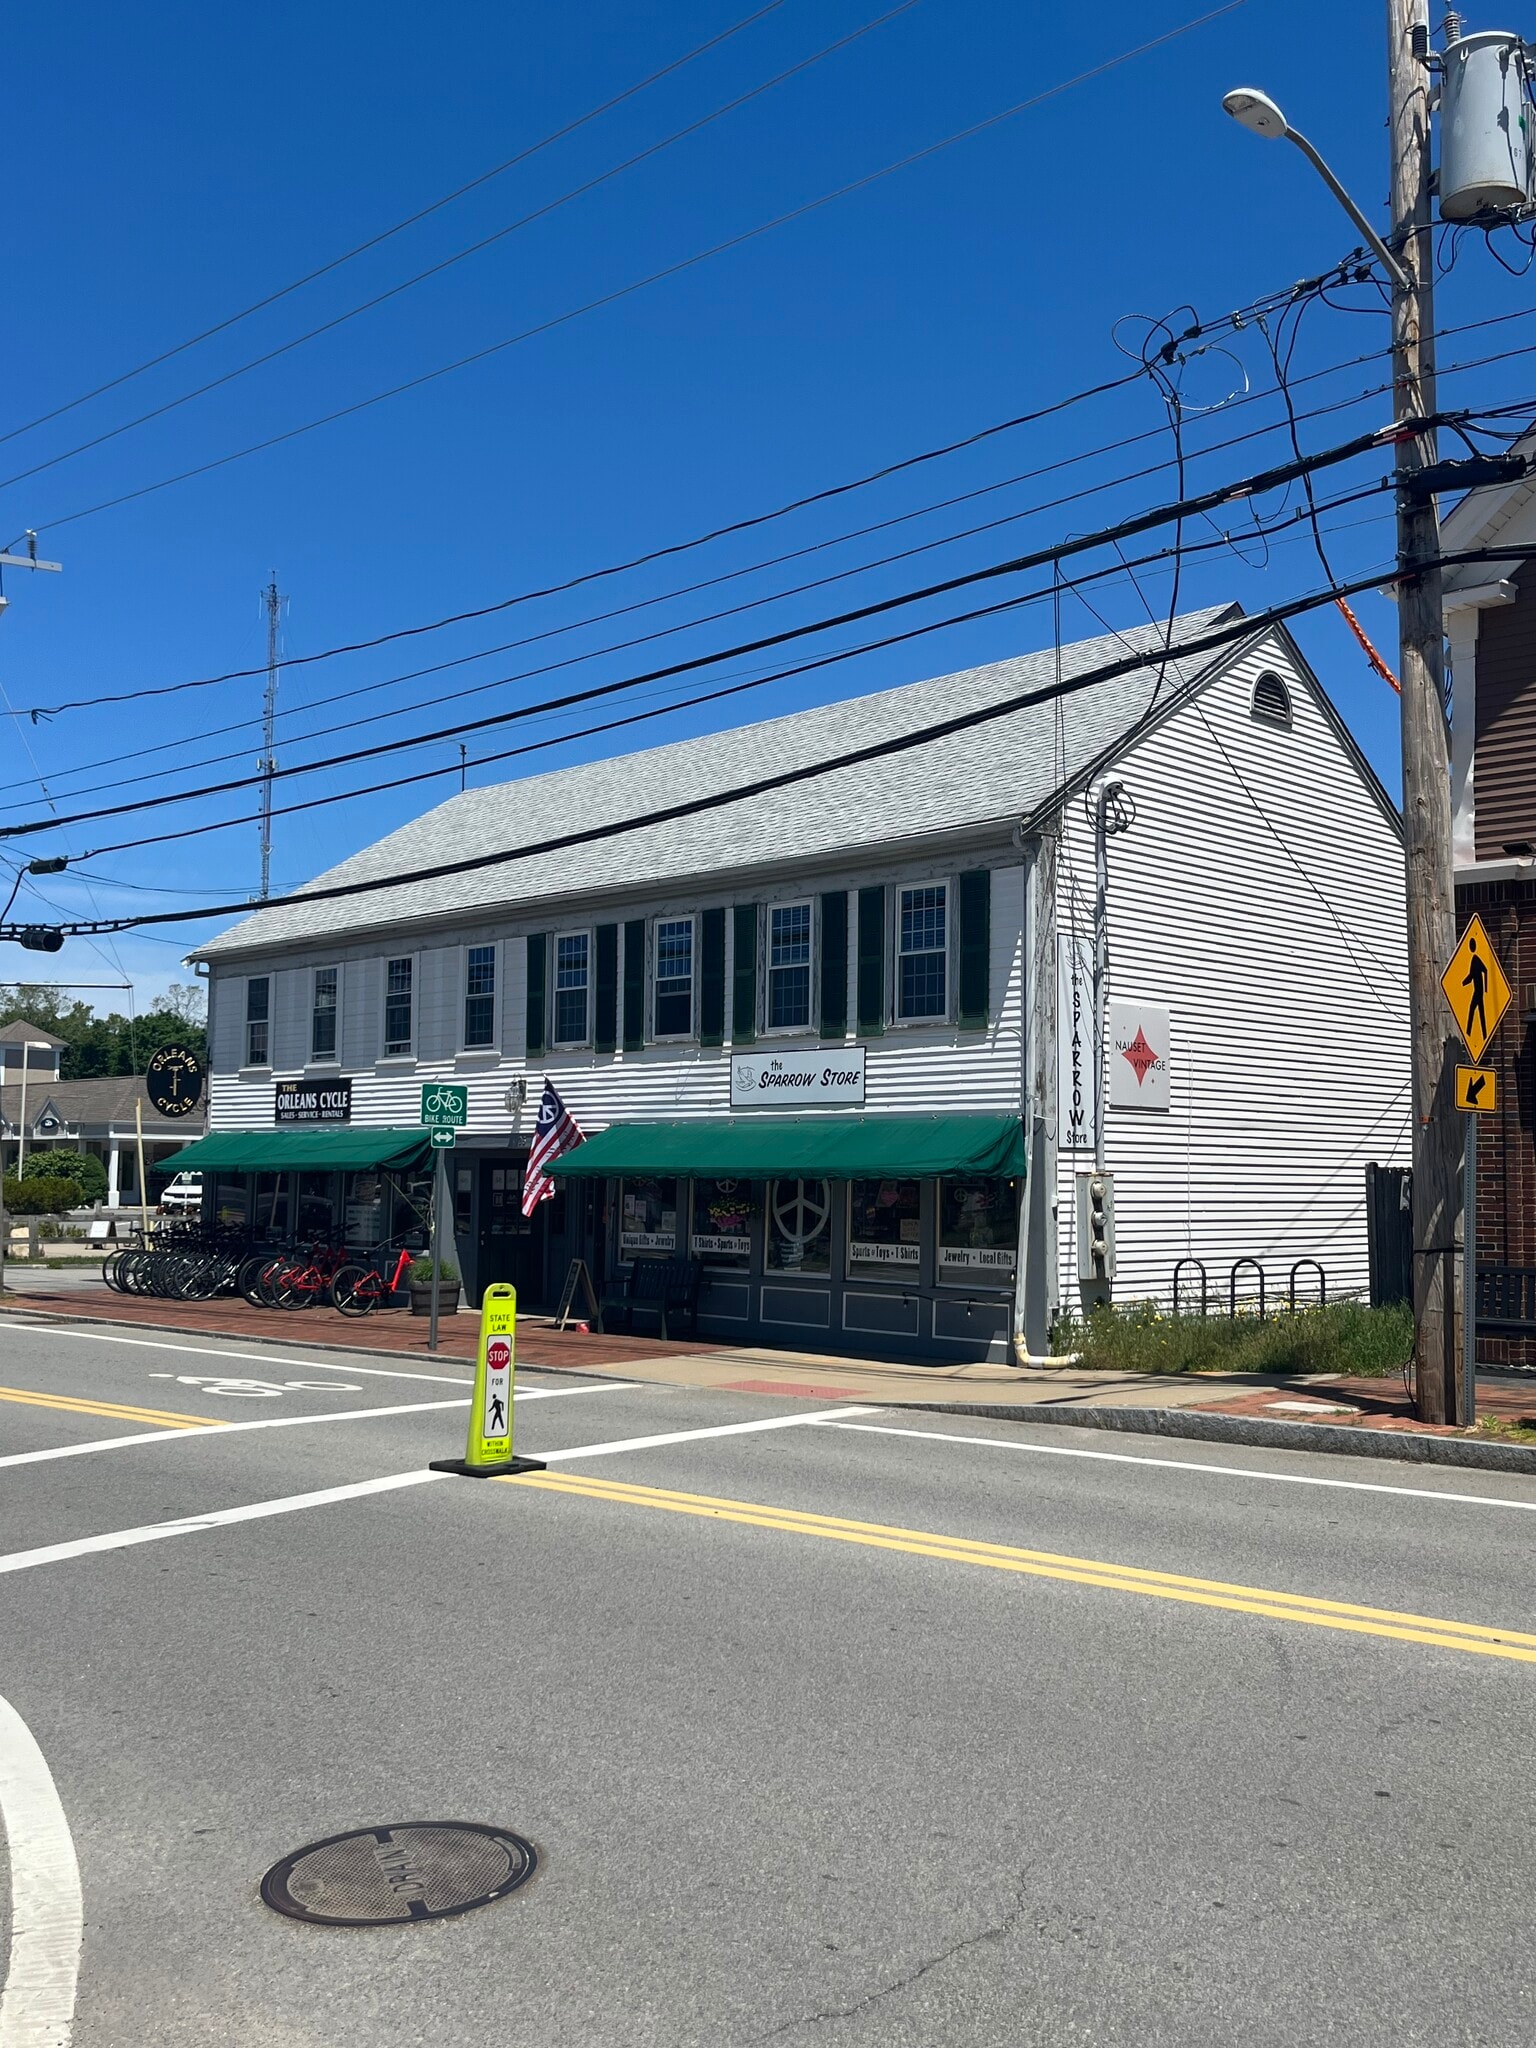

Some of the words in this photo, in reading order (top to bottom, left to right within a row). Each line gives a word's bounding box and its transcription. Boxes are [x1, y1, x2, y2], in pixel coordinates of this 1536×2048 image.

[1071, 973, 1083, 986] the
[1115, 1040, 1145, 1053] NAUSET
[152, 1048, 198, 1073] ORLEANS
[770, 1059, 783, 1071] the
[1069, 991, 1084, 1126] SPARROW
[1133, 1058, 1166, 1071] VINTAGE
[758, 1071, 817, 1089] SPARROW
[820, 1068, 861, 1086] STORE
[281, 1083, 298, 1092] THE
[157, 1097, 193, 1113] CYCLE
[277, 1092, 317, 1110] ORLEANS
[320, 1091, 349, 1108] CYCLE
[280, 1111, 295, 1119] SALES
[298, 1110, 319, 1119] SERVICE
[321, 1109, 344, 1118] RENTALS
[424, 1114, 440, 1123] BIKE
[442, 1115, 463, 1124] ROUTE
[1066, 1130, 1088, 1144] Store
[852, 1245, 870, 1259] Sports
[876, 1246, 890, 1260] Toys
[944, 1249, 970, 1265] Jewelry
[980, 1251, 996, 1264] Local
[997, 1252, 1012, 1265] Gifts
[489, 1314, 510, 1322] STATE
[492, 1323, 507, 1332] LAW
[488, 1351, 510, 1362] STOP
[491, 1377, 504, 1386] FOR
